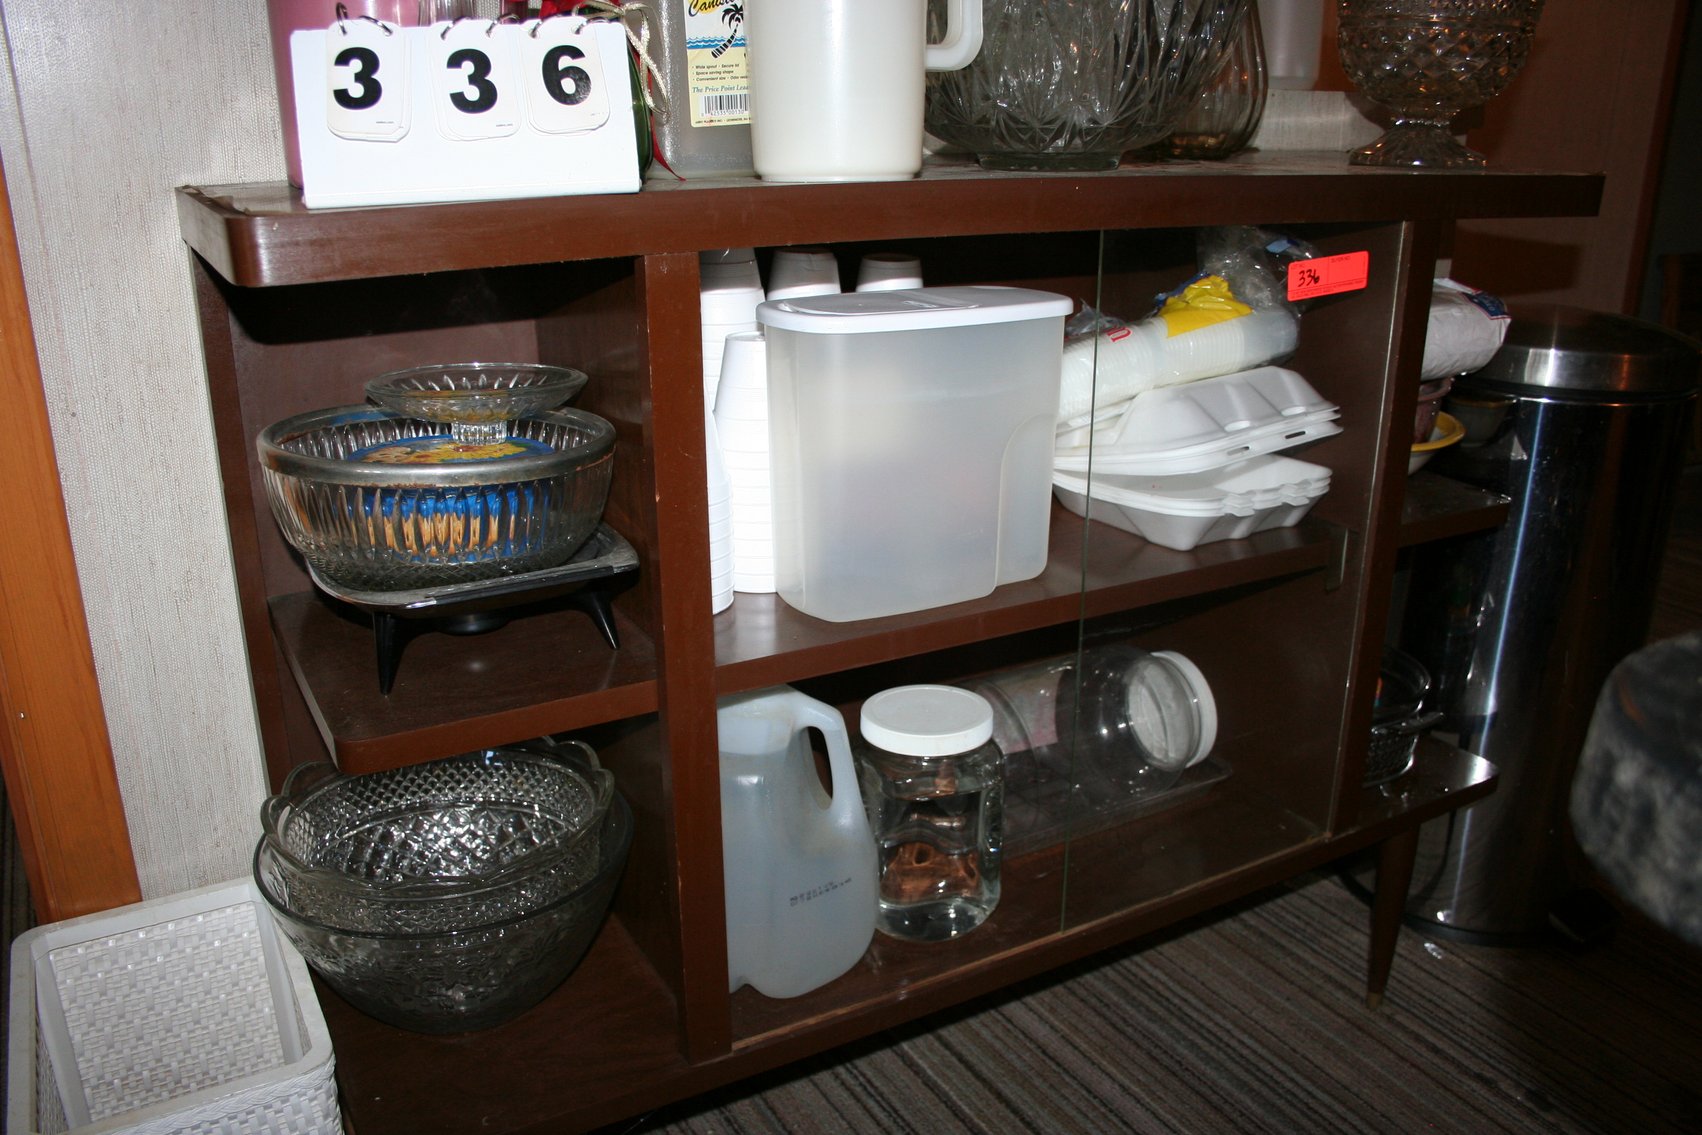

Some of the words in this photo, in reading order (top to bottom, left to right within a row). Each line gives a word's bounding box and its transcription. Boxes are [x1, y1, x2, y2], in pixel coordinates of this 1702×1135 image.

[333, 46, 383, 110] 3
[446, 48, 498, 114] 3
[542, 44, 592, 106] 6
[1298, 268, 1320, 287] 336
